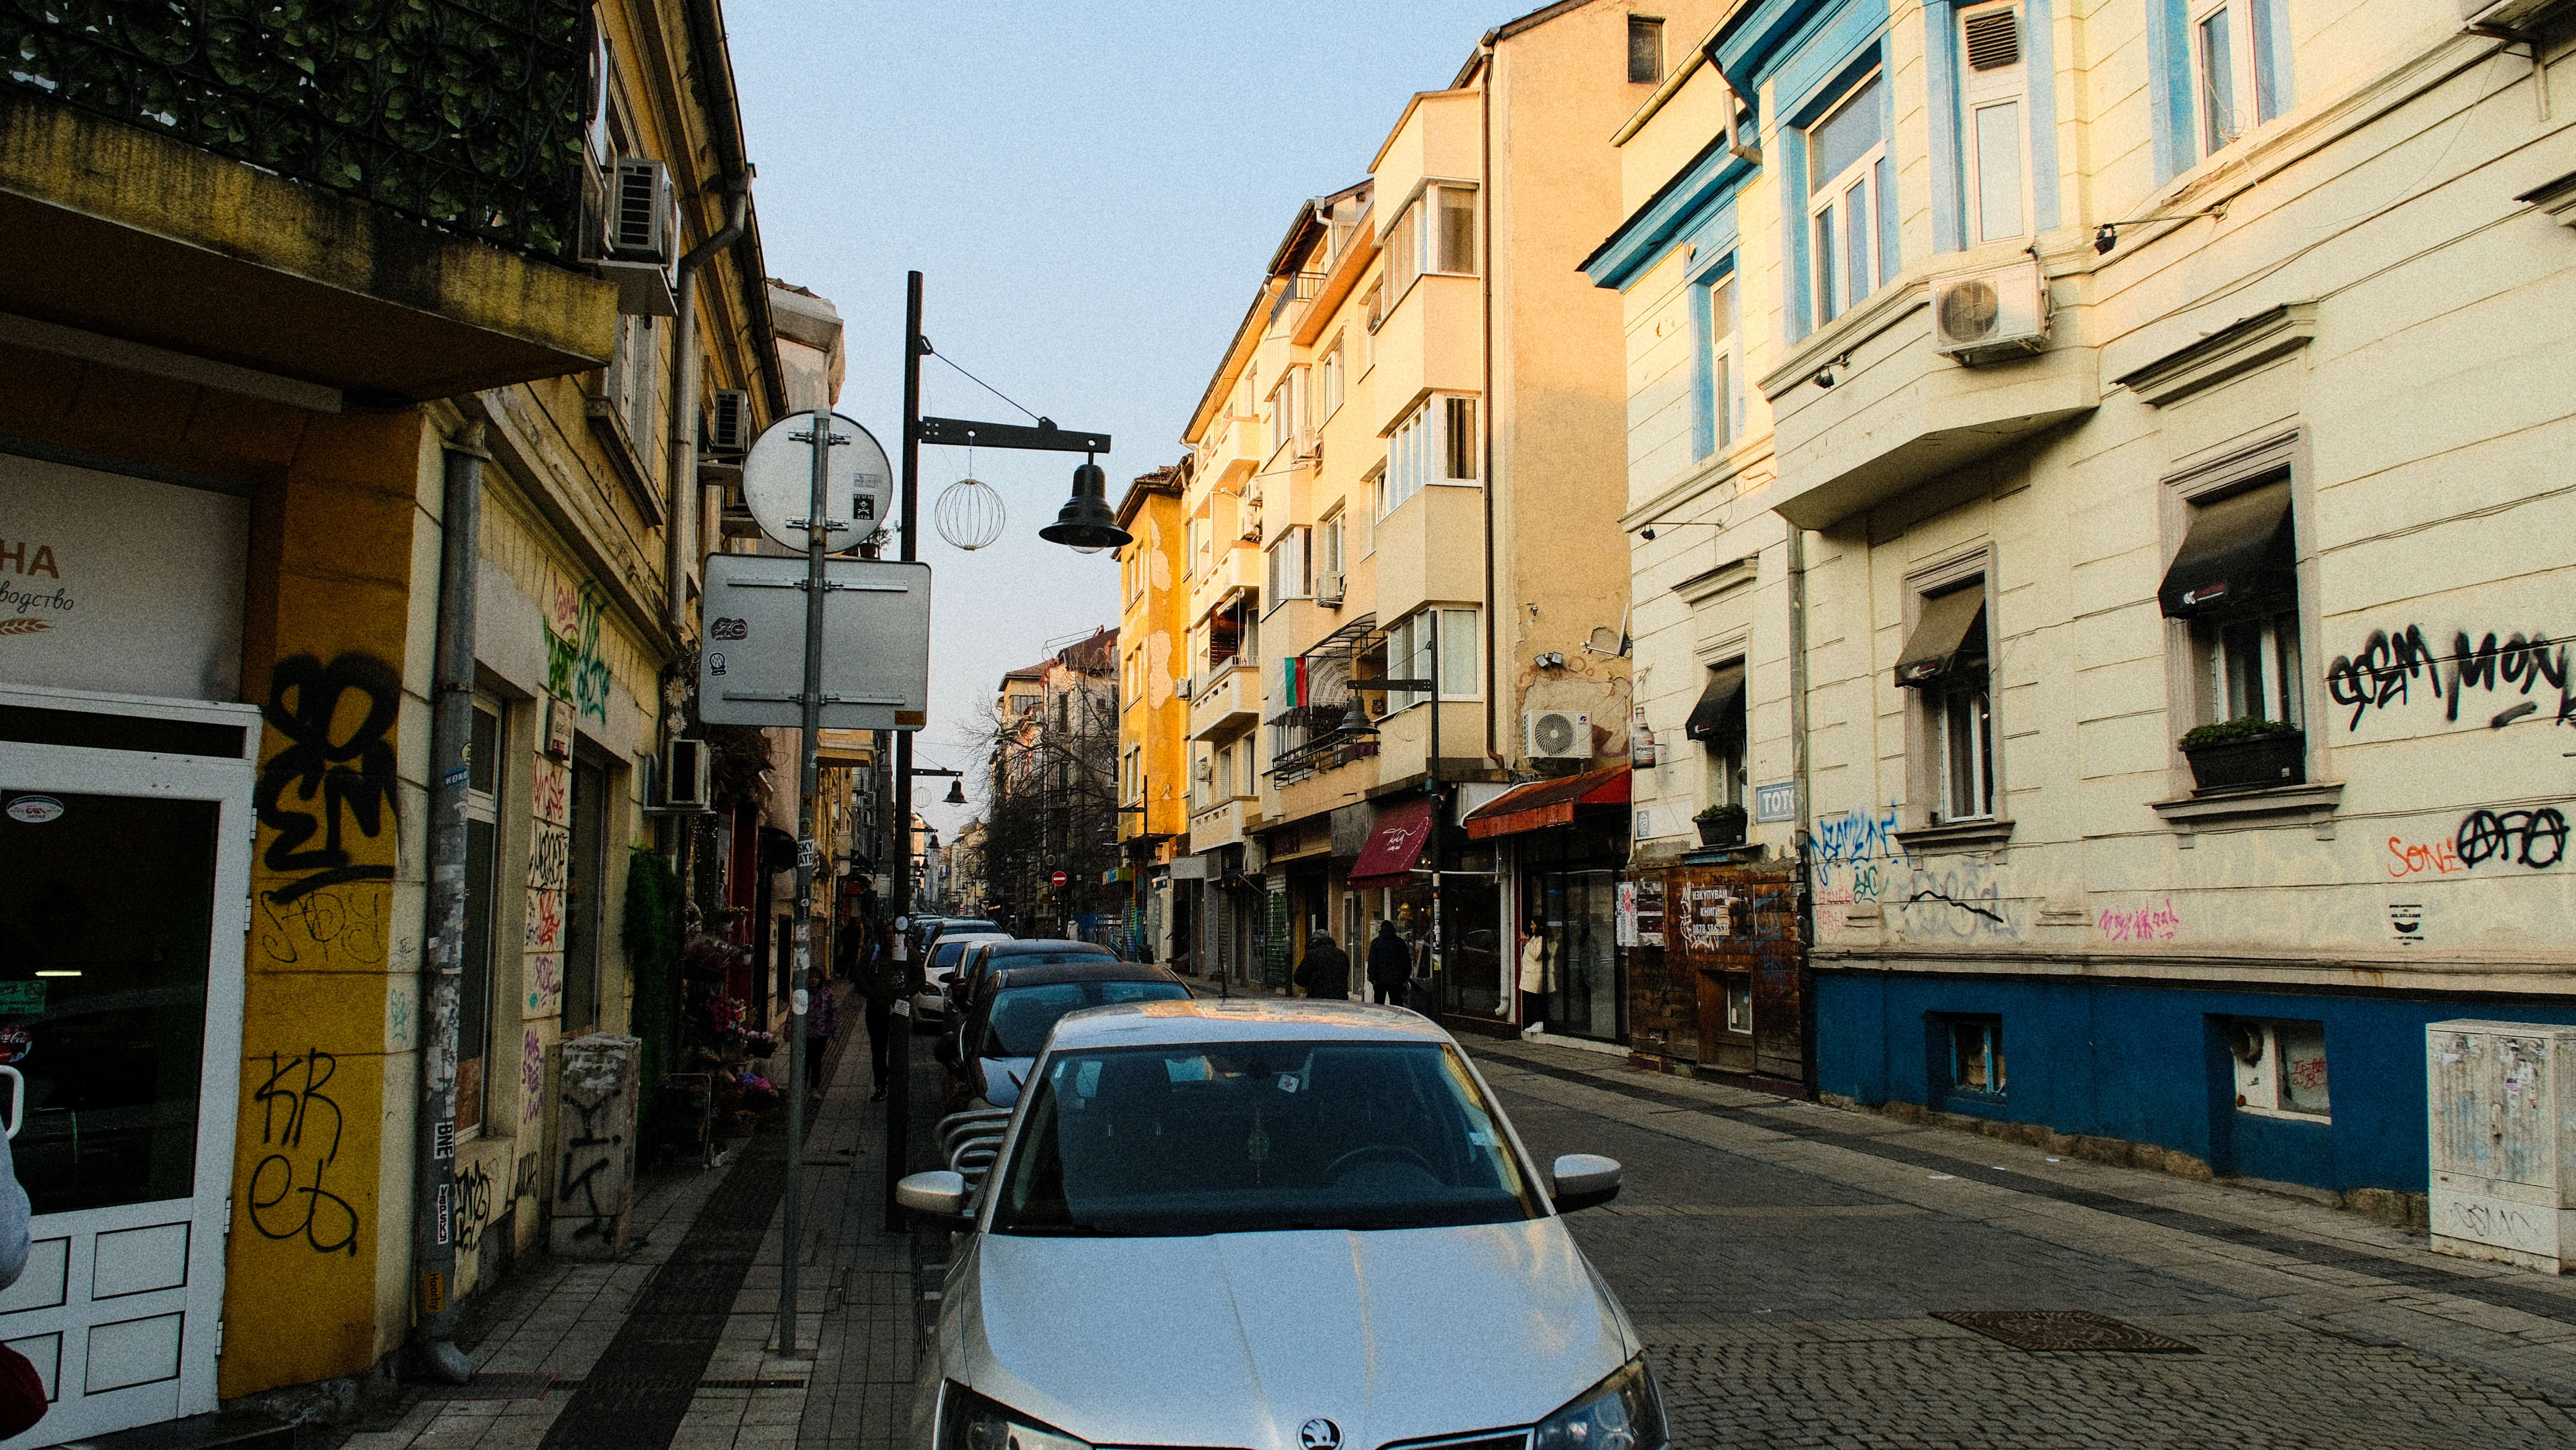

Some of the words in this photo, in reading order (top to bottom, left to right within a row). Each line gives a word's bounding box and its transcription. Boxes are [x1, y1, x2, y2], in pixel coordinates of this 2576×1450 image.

[797, 841, 813, 853] SKY
[1692, 889, 1728, 900] ИЗКУПУВАМ
[1700, 907, 1720, 917] КНИГИ
[1692, 923, 1706, 934] 0878
[437, 1124, 453, 1157] BNE
